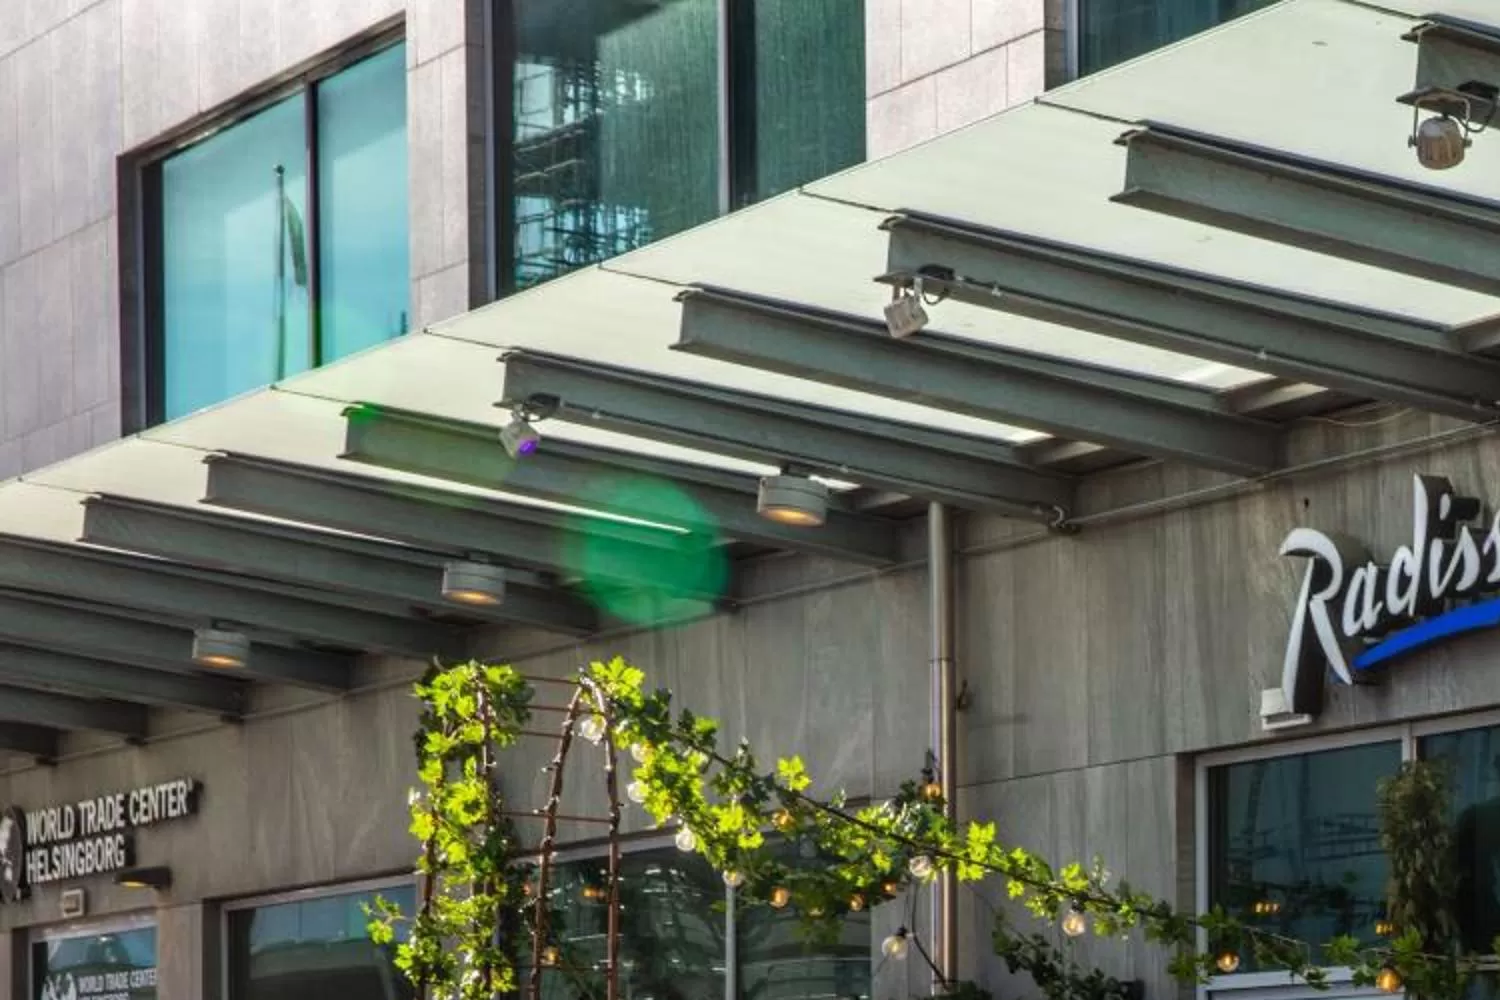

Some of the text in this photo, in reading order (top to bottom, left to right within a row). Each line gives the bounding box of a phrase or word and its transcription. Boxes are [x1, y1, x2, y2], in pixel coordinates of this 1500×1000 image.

[26, 804, 76, 844] WORLD
[77, 793, 125, 836] TRADE
[26, 834, 126, 884] HELSINGBORG
